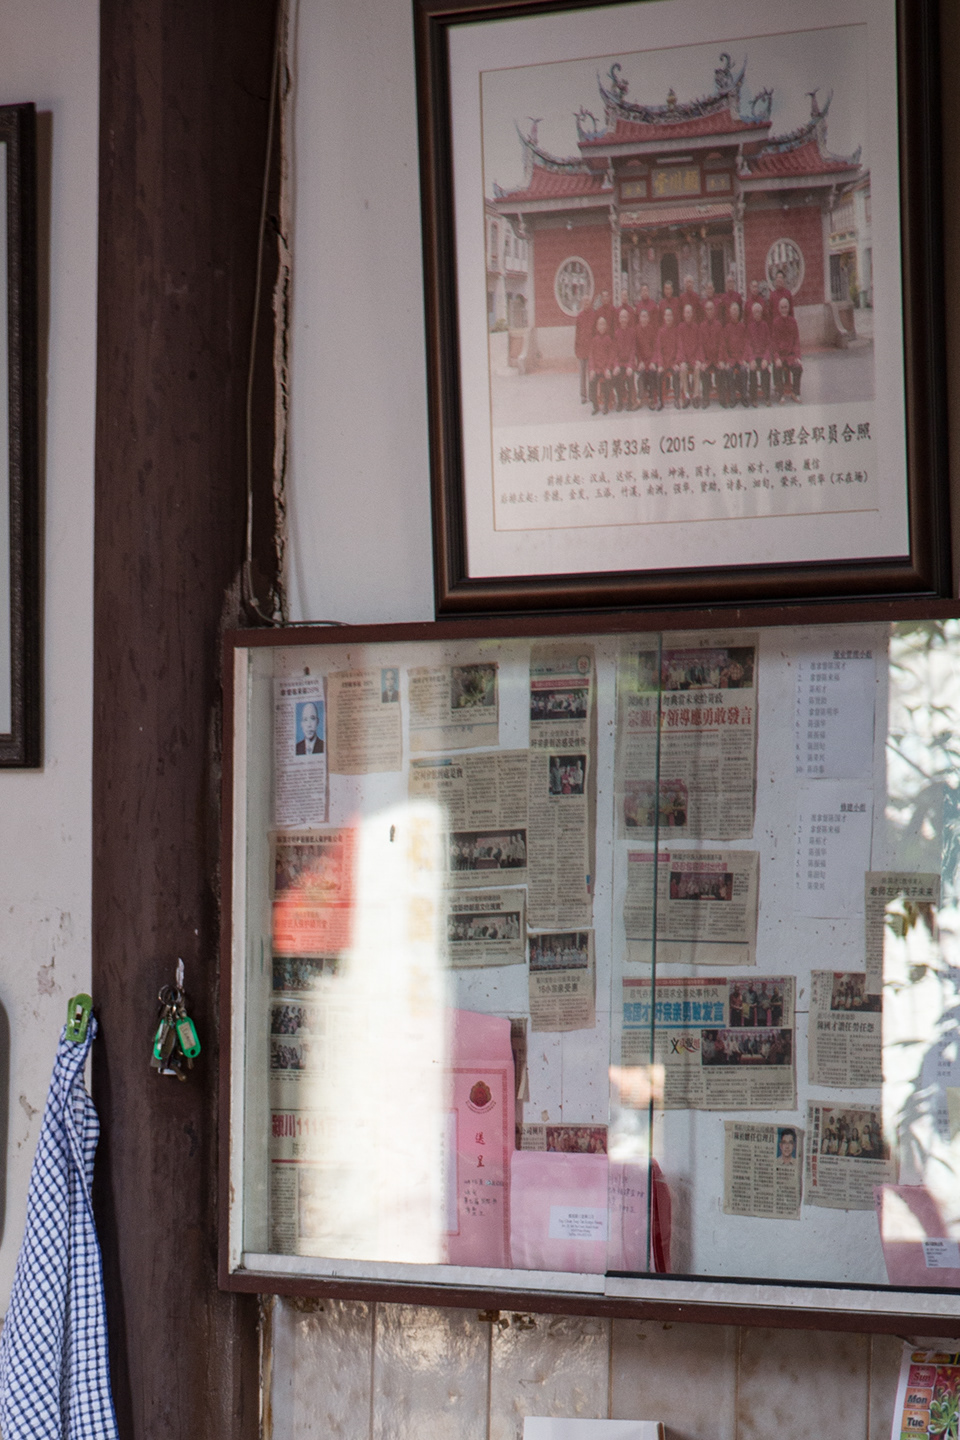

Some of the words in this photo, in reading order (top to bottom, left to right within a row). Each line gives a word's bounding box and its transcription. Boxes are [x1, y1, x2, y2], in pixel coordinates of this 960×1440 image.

[913, 1373, 931, 1381] Sun
[907, 1395, 928, 1404] Mon
[906, 1417, 924, 1427] Tue
